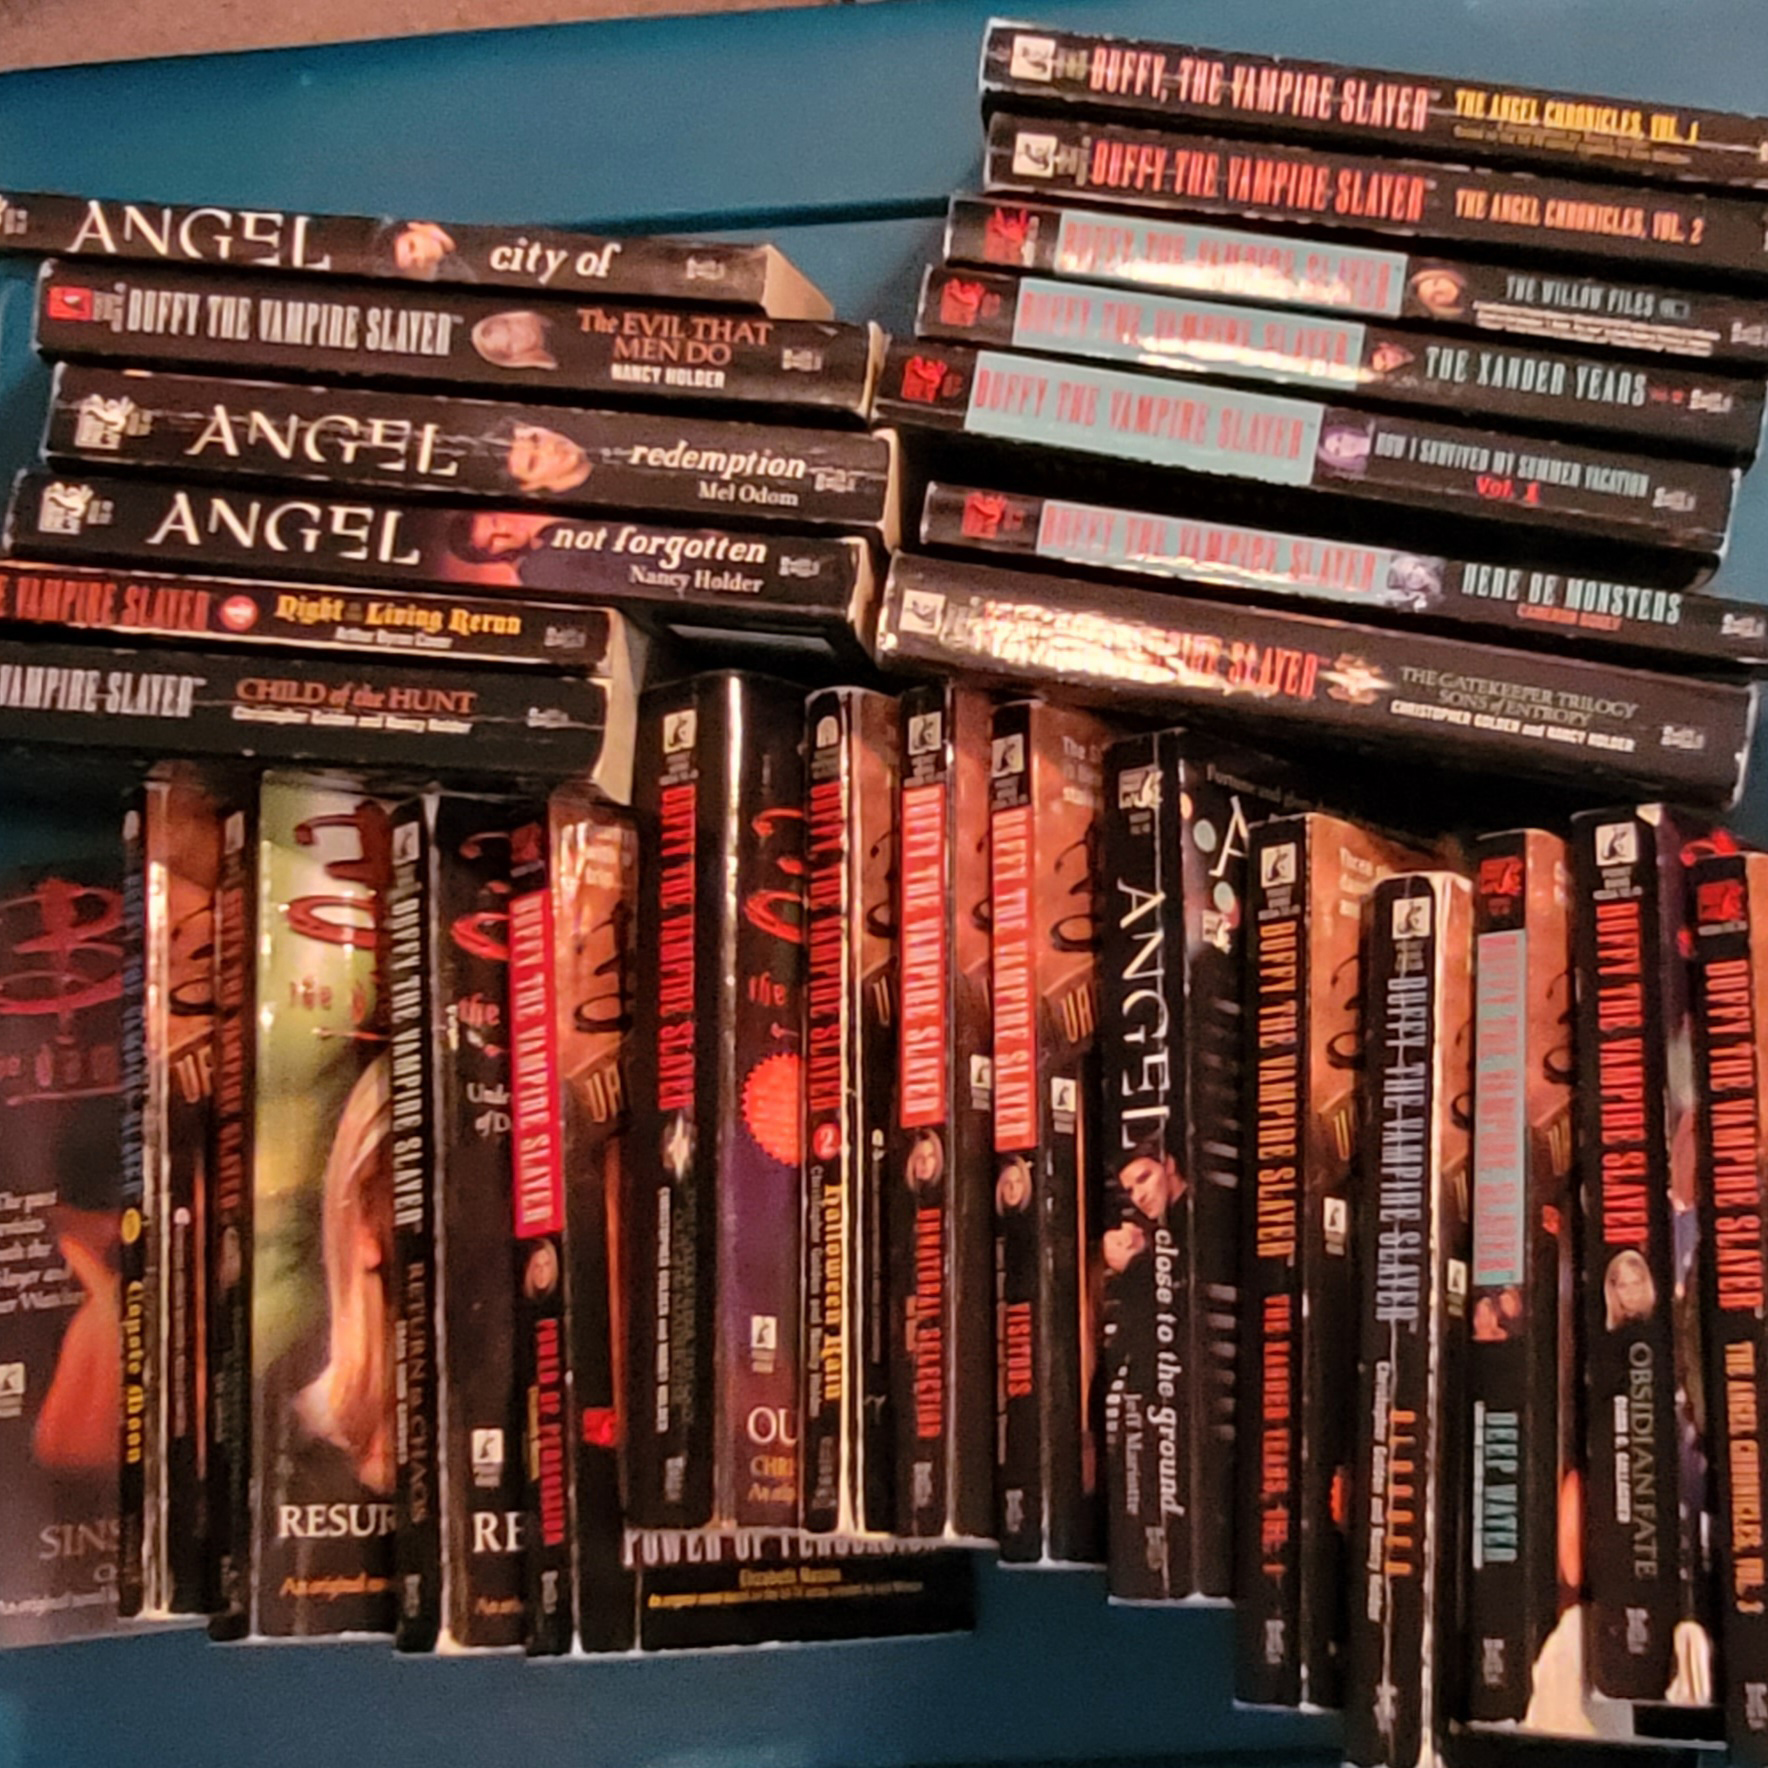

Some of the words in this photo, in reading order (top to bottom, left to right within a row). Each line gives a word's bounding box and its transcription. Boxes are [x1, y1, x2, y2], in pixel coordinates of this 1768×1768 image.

[1179, 57, 1224, 105] THE
[1231, 65, 1334, 121] VAMPIRE
[1341, 76, 1429, 131] SLAYER
[1454, 87, 1487, 119] THE
[1489, 93, 1539, 126] ANGEL
[1091, 140, 1167, 192] BUFFY
[1174, 150, 1219, 198] THE
[1228, 156, 1328, 211] VAMPIRE
[1334, 167, 1425, 222] SLAYER
[66, 200, 330, 270] ANGEL
[1455, 188, 1488, 219] THE
[1489, 193, 1540, 226] ANGEL
[1690, 217, 1704, 245] 2
[489, 236, 568, 285] city
[576, 242, 621, 278] of
[127, 288, 200, 335] BUFFY
[207, 295, 250, 340] THE
[259, 298, 359, 350] VAMPIRE
[365, 306, 451, 356] SLAYER
[577, 308, 620, 334] The
[622, 311, 688, 340] EVIL
[691, 318, 774, 346] THAT
[1102, 301, 1142, 345] THE
[1506, 275, 1535, 304] THE
[1542, 280, 1603, 310] WILLOW
[1607, 287, 1654, 317] FILES
[612, 336, 679, 362] MEN
[686, 342, 732, 366] DO
[1425, 347, 1467, 384] THE
[1475, 350, 1565, 396] XANDER
[1575, 364, 1648, 407] YEARS
[184, 404, 458, 477] ANGEL
[975, 368, 1048, 418] BUFFY
[1056, 381, 1101, 427] THE
[1109, 387, 1209, 444] VAMPIRE
[1217, 405, 1304, 461] SLAYER
[629, 440, 807, 480] redemption
[698, 480, 737, 499] Mel
[738, 482, 800, 508] Odom
[1374, 431, 1406, 459] HOW
[1491, 451, 1516, 476] MY
[1517, 455, 1581, 487] SUMMER
[1585, 465, 1650, 499] VACATION
[1476, 475, 1515, 499] Vol.
[1523, 481, 1541, 506] 1
[145, 491, 421, 566] ANGEL
[551, 525, 607, 552] not
[611, 525, 768, 570] forgotten
[1041, 505, 1117, 551] BUFFY
[1125, 515, 1167, 559] THE
[1179, 521, 1279, 572] VAMPIRE
[1289, 533, 1377, 593] SLAYER
[15, 576, 117, 626] VAMPIRE
[124, 584, 211, 632] SLAYER
[629, 564, 690, 599] Nancy
[694, 569, 765, 594] Holder
[1462, 562, 1520, 601] HERE
[1528, 571, 1558, 605] BE
[1566, 579, 1683, 626] MONSTERS
[0, 665, 101, 712] VAMPIRE
[105, 672, 195, 718] SLAYER
[235, 677, 327, 705] CHILD
[390, 687, 477, 713] HUNT
[1228, 640, 1319, 700] SLAYER
[1400, 665, 1438, 687] THE
[1439, 671, 1556, 705] GATEKEEPER
[1557, 690, 1639, 720] TRILOGY
[1438, 689, 1488, 711] SONS
[1505, 700, 1593, 728] ENTROPY
[903, 786, 941, 857] BUFFY
[993, 808, 1028, 879] BUFFY
[661, 861, 696, 909] THE
[809, 863, 842, 911] THE
[904, 864, 941, 911] THE
[993, 887, 1028, 933] THE
[391, 900, 421, 970] BUFFY
[660, 914, 695, 1017] VAMPIRE
[809, 915, 842, 1018] VAMPIRE
[904, 917, 942, 1021] VAMPIRE
[1258, 921, 1296, 995] BUFFY
[1596, 902, 1640, 976] BUFFY
[391, 975, 422, 1024] THE
[458, 993, 501, 1028] the
[514, 972, 546, 1024] THE
[994, 941, 1029, 1041] VAMPIRE
[1117, 877, 1171, 1149] ANGEL
[1258, 1000, 1296, 1047] THE
[1385, 977, 1427, 1048] BUFFY
[1598, 981, 1641, 1031] THE
[1705, 959, 1750, 1034] BUFFY
[391, 1028, 422, 1130] VAMPIRE
[515, 1026, 550, 1131] VAMPIRE
[659, 1020, 695, 1111] SLAYER
[809, 1022, 842, 1111] SLAYER
[904, 1026, 941, 1116] SLAYER
[995, 1053, 1030, 1138] SLAYER
[1382, 1063, 1426, 1109] THE
[1600, 1037, 1644, 1146] VAMPIRE
[1708, 1042, 1756, 1091] THE
[819, 1129, 834, 1151] 2
[1258, 1054, 1296, 1160] VAMPIRE
[392, 1136, 423, 1226] SLAYER
[519, 1135, 553, 1224] SLAYER
[1379, 1116, 1425, 1222] VAMPIRE
[1710, 1100, 1759, 1208] VAMPIRE
[1257, 1167, 1296, 1257] SLAYER
[1601, 1151, 1647, 1245] SLAYER
[823, 1184, 843, 1326] Halloween
[1154, 1229, 1179, 1304] close
[1375, 1231, 1422, 1321] SLAYER
[1715, 1215, 1764, 1309] SLAYER
[1007, 1303, 1032, 1398] VISITORS
[1156, 1313, 1178, 1342] to
[1724, 1341, 1756, 1376] THE
[1156, 1351, 1182, 1397] the
[1726, 1380, 1757, 1436] ANGEL
[1124, 1393, 1143, 1430] Jeff
[1485, 1412, 1518, 1473] DEEP
[1628, 1341, 1657, 1496] OBSIDIAN
[1124, 1432, 1142, 1516] Mariotte
[1147, 1404, 1185, 1517] ground
[1484, 1484, 1518, 1563] WATER
[1634, 1502, 1657, 1578] FATE
